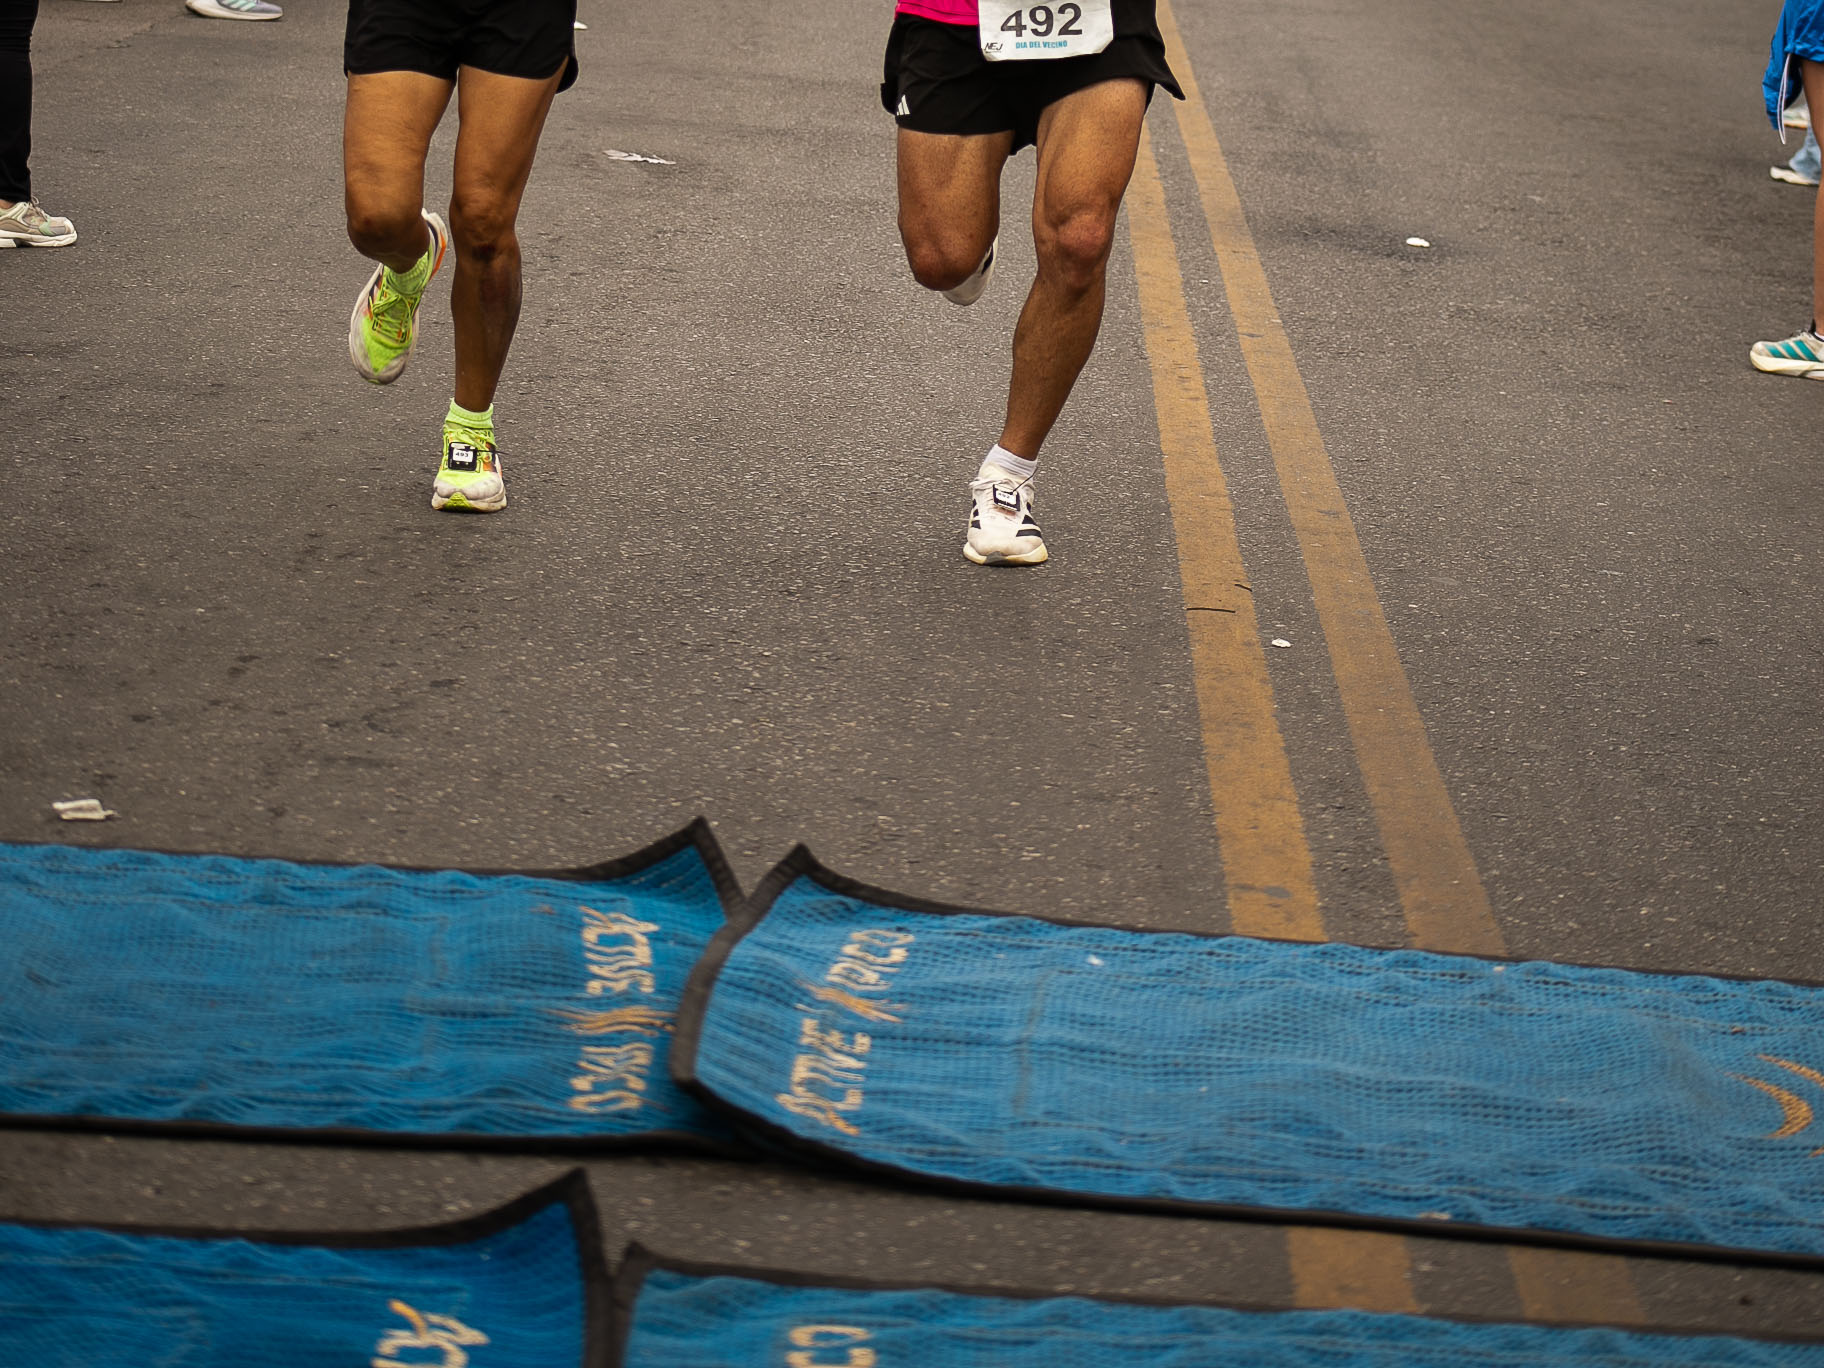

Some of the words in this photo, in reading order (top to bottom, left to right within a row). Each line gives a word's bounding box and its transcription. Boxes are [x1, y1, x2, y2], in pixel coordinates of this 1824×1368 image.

[1000, 2, 1083, 38] 492
[1015, 41, 1028, 49] DIA
[1029, 41, 1042, 49] DEL
[1042, 40, 1068, 49] VECINO
